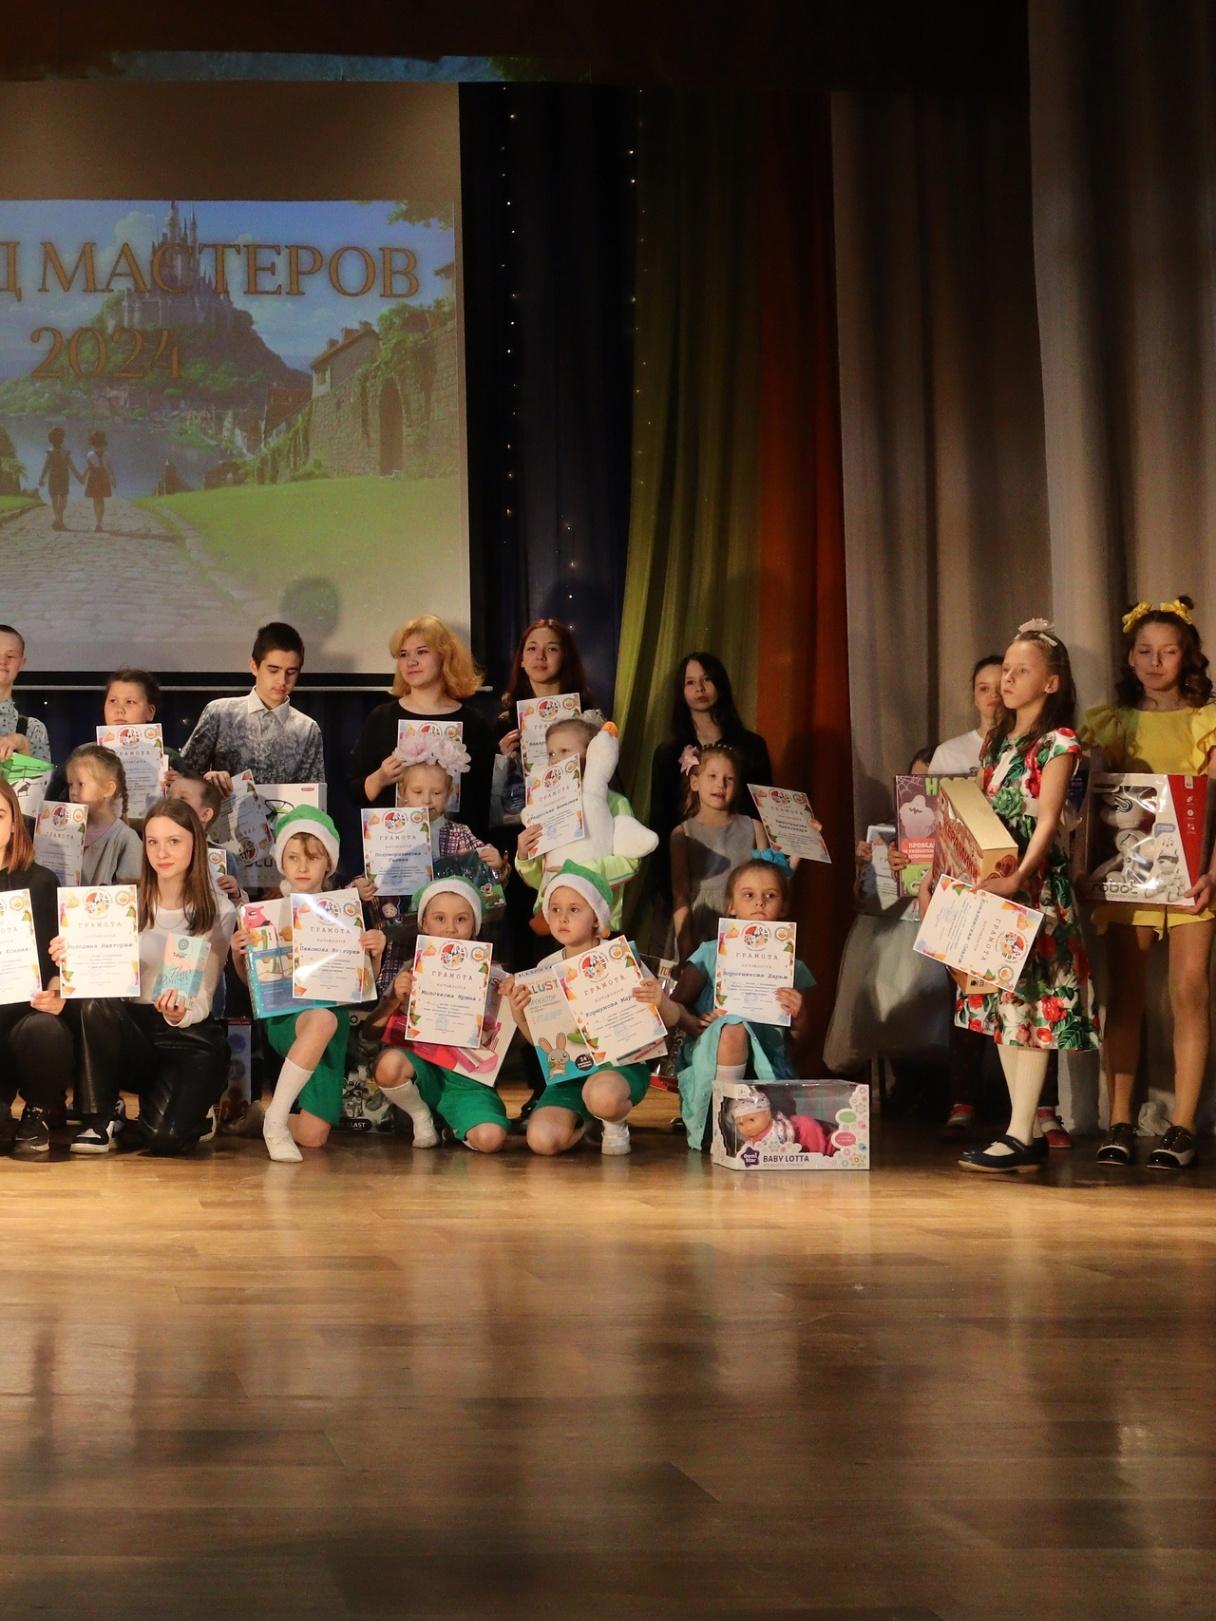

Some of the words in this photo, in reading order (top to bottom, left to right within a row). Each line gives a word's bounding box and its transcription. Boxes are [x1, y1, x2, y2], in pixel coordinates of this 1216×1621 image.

[40, 241, 420, 298] МАСТЕРОВ
[30, 326, 181, 380] 2024
[763, 1155, 784, 1163] BABY
[785, 1155, 810, 1163] LOTTA
